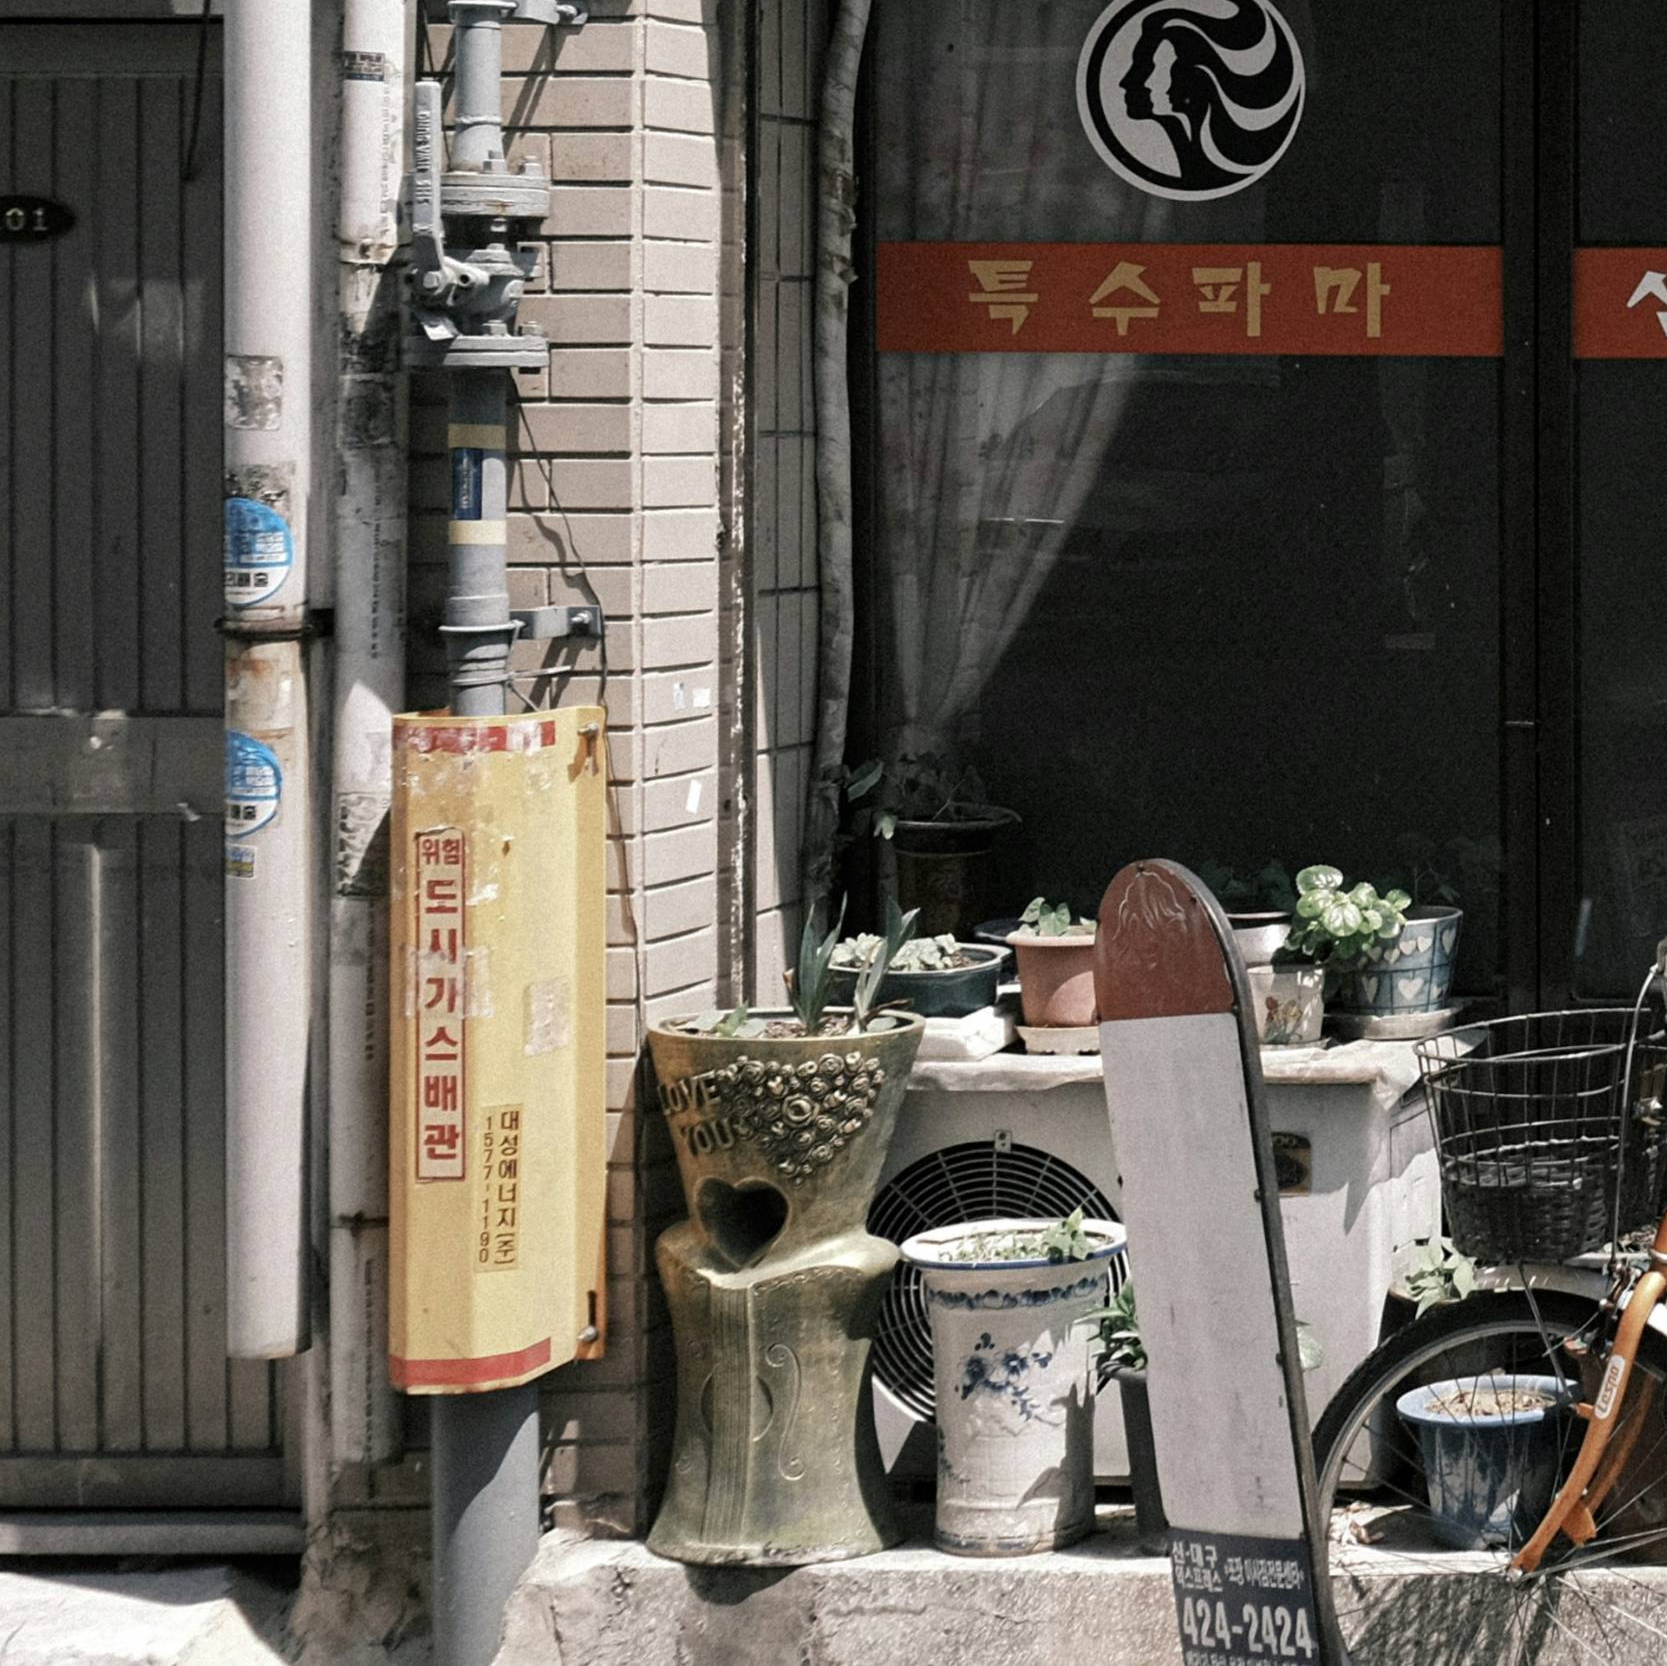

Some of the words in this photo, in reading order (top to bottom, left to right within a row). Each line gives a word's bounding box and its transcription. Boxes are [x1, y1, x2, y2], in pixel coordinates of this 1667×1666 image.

[5, 206, 49, 231] 01
[422, 838, 461, 866] 위험
[424, 879, 460, 1160] 도시가스배관
[657, 1069, 722, 1116] LOVE
[680, 1117, 735, 1157] YOU
[479, 1116, 494, 1264] 1577-1190
[494, 1110, 520, 1265] 대성에너지(주)
[1183, 1597, 1313, 1659] 424-2424
